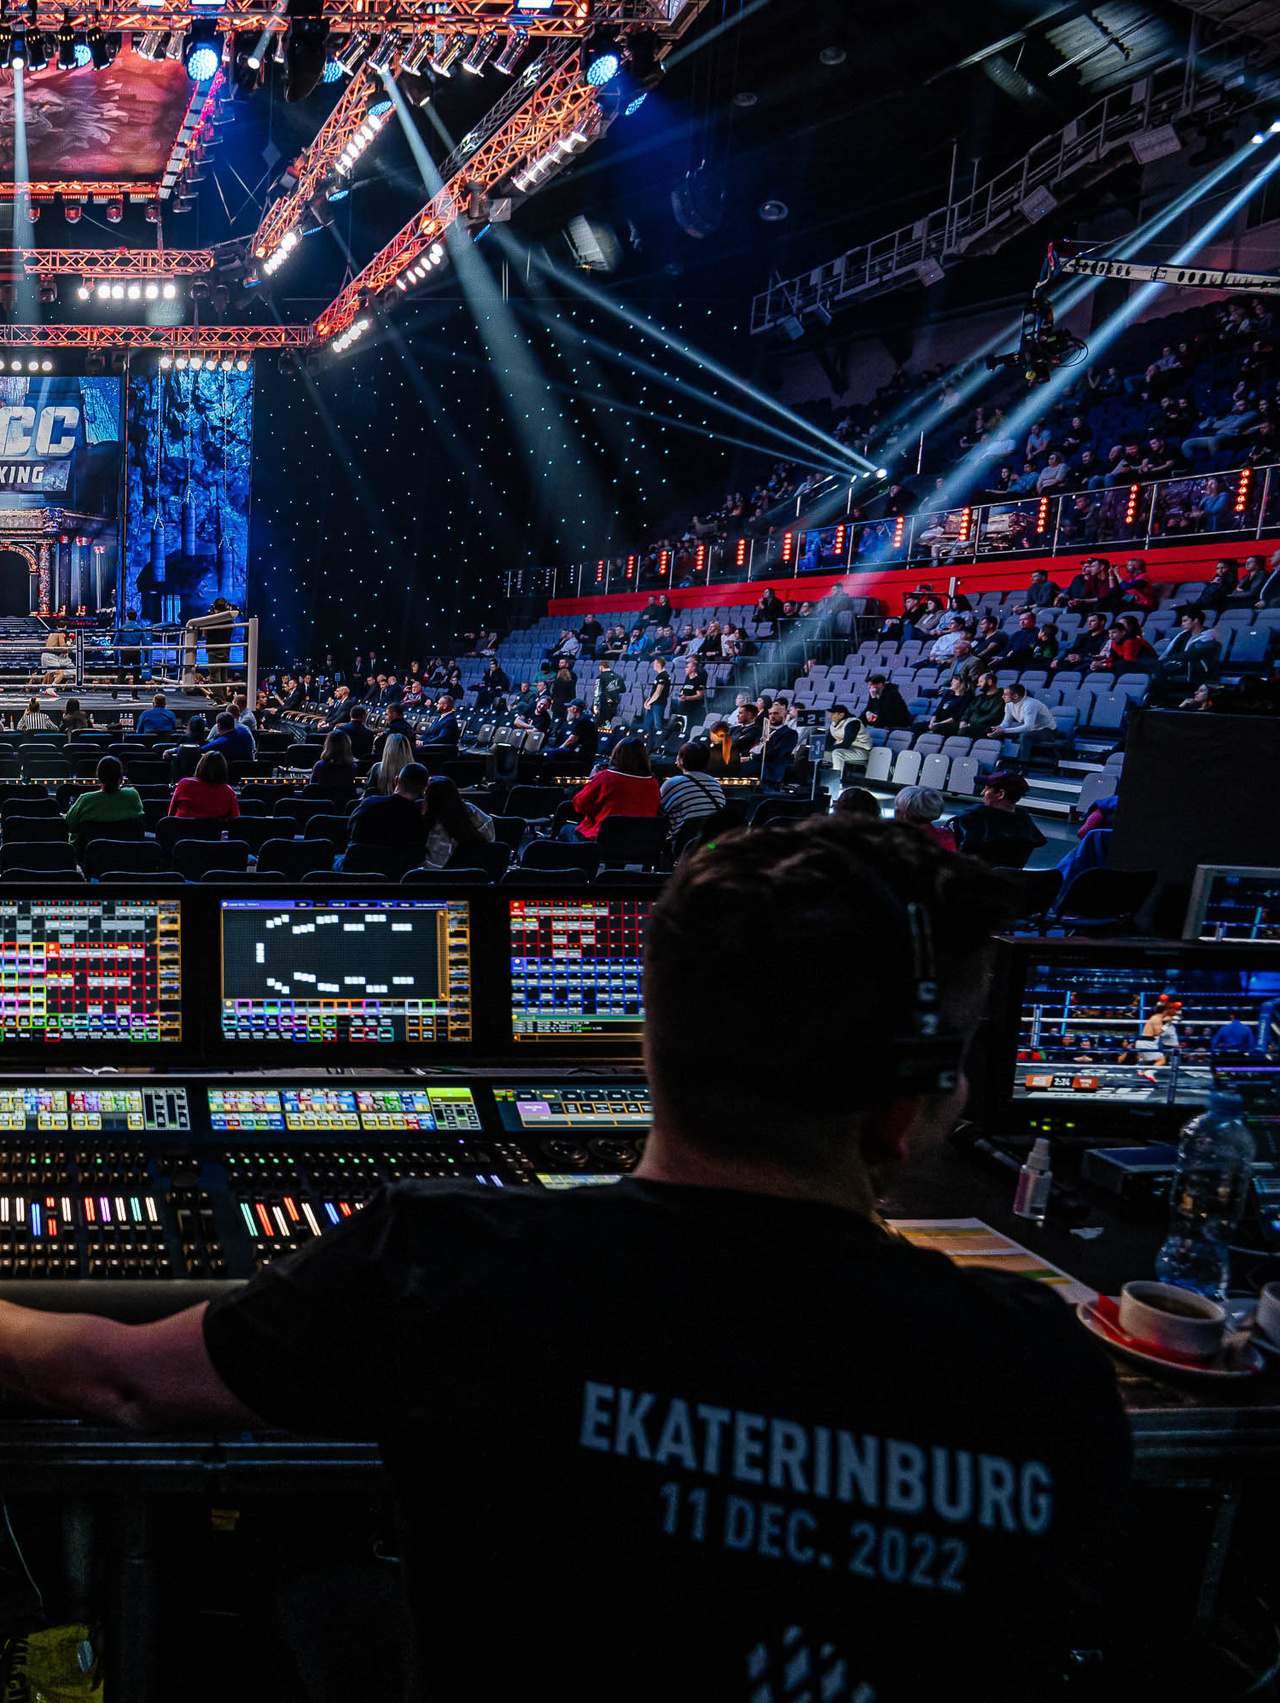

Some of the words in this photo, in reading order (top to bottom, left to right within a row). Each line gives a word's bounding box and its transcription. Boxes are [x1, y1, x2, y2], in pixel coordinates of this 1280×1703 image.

[580, 1381, 1052, 1533] EKATERINBURG
[661, 1483, 707, 1540] 11
[725, 1495, 833, 1568] DEC.
[849, 1522, 966, 1592] 2022
